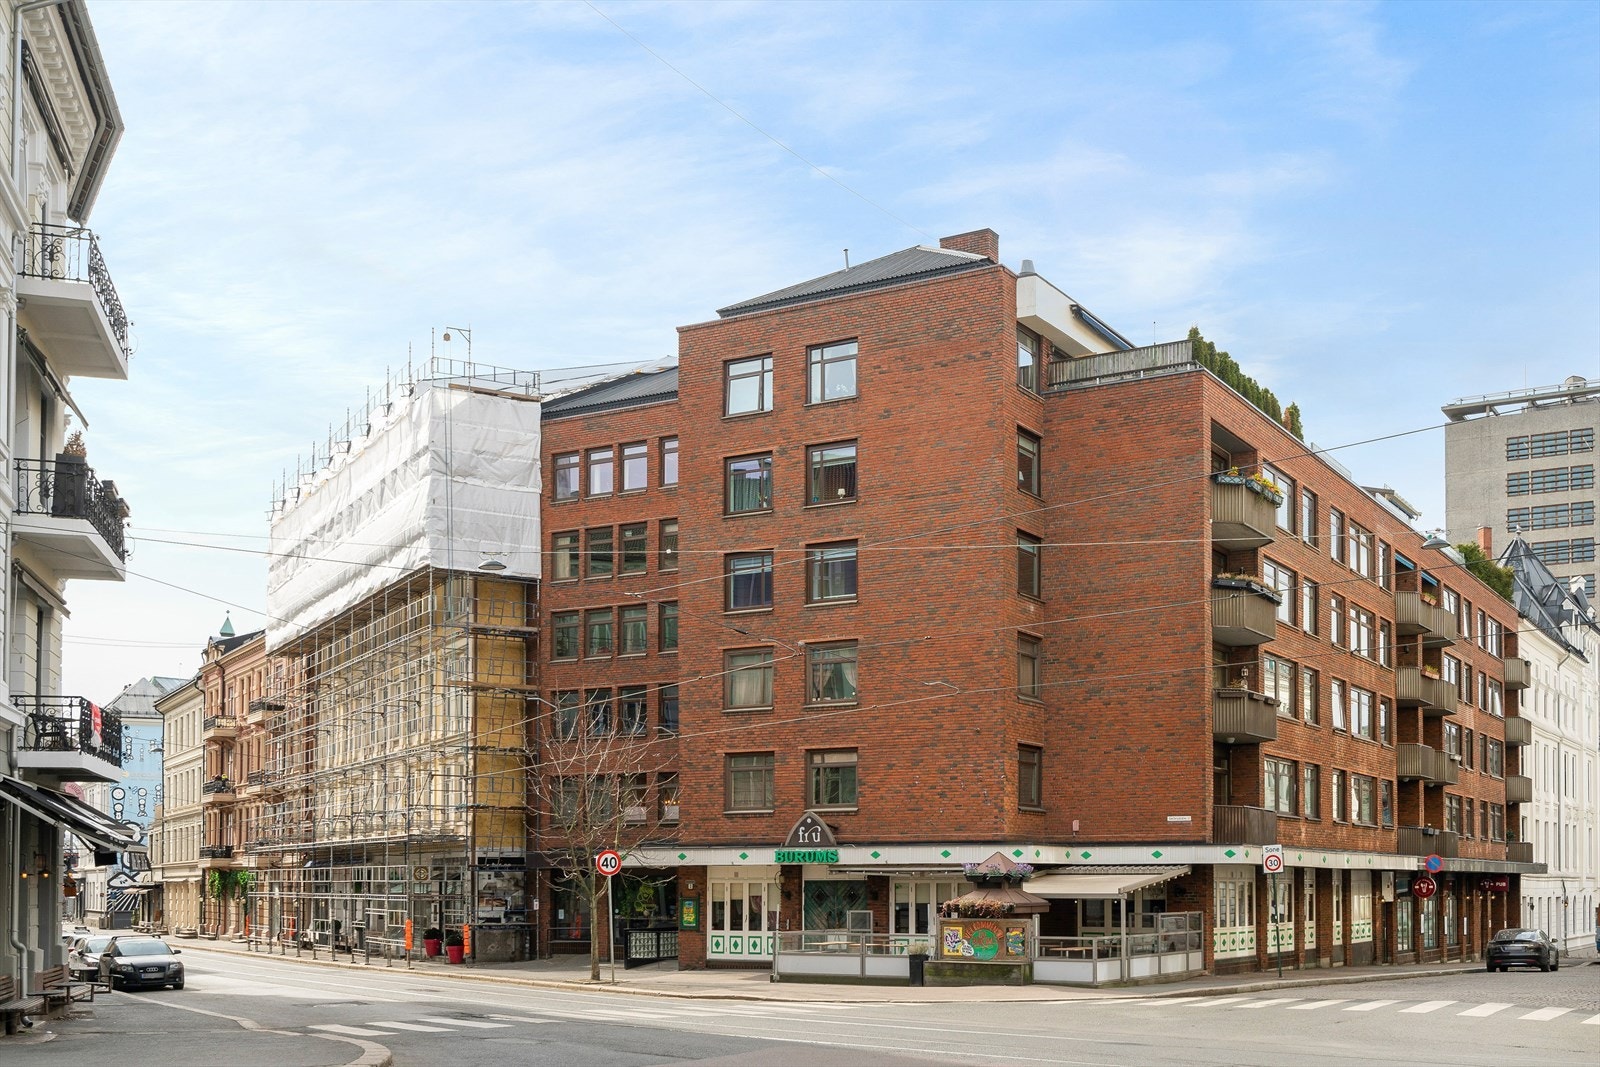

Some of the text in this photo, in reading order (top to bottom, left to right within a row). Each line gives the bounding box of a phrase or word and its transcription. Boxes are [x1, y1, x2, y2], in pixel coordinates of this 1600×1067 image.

[798, 825, 822, 843] fru
[601, 856, 618, 869] 40
[774, 849, 839, 863] BURUMS
[1268, 859, 1279, 867] 30
